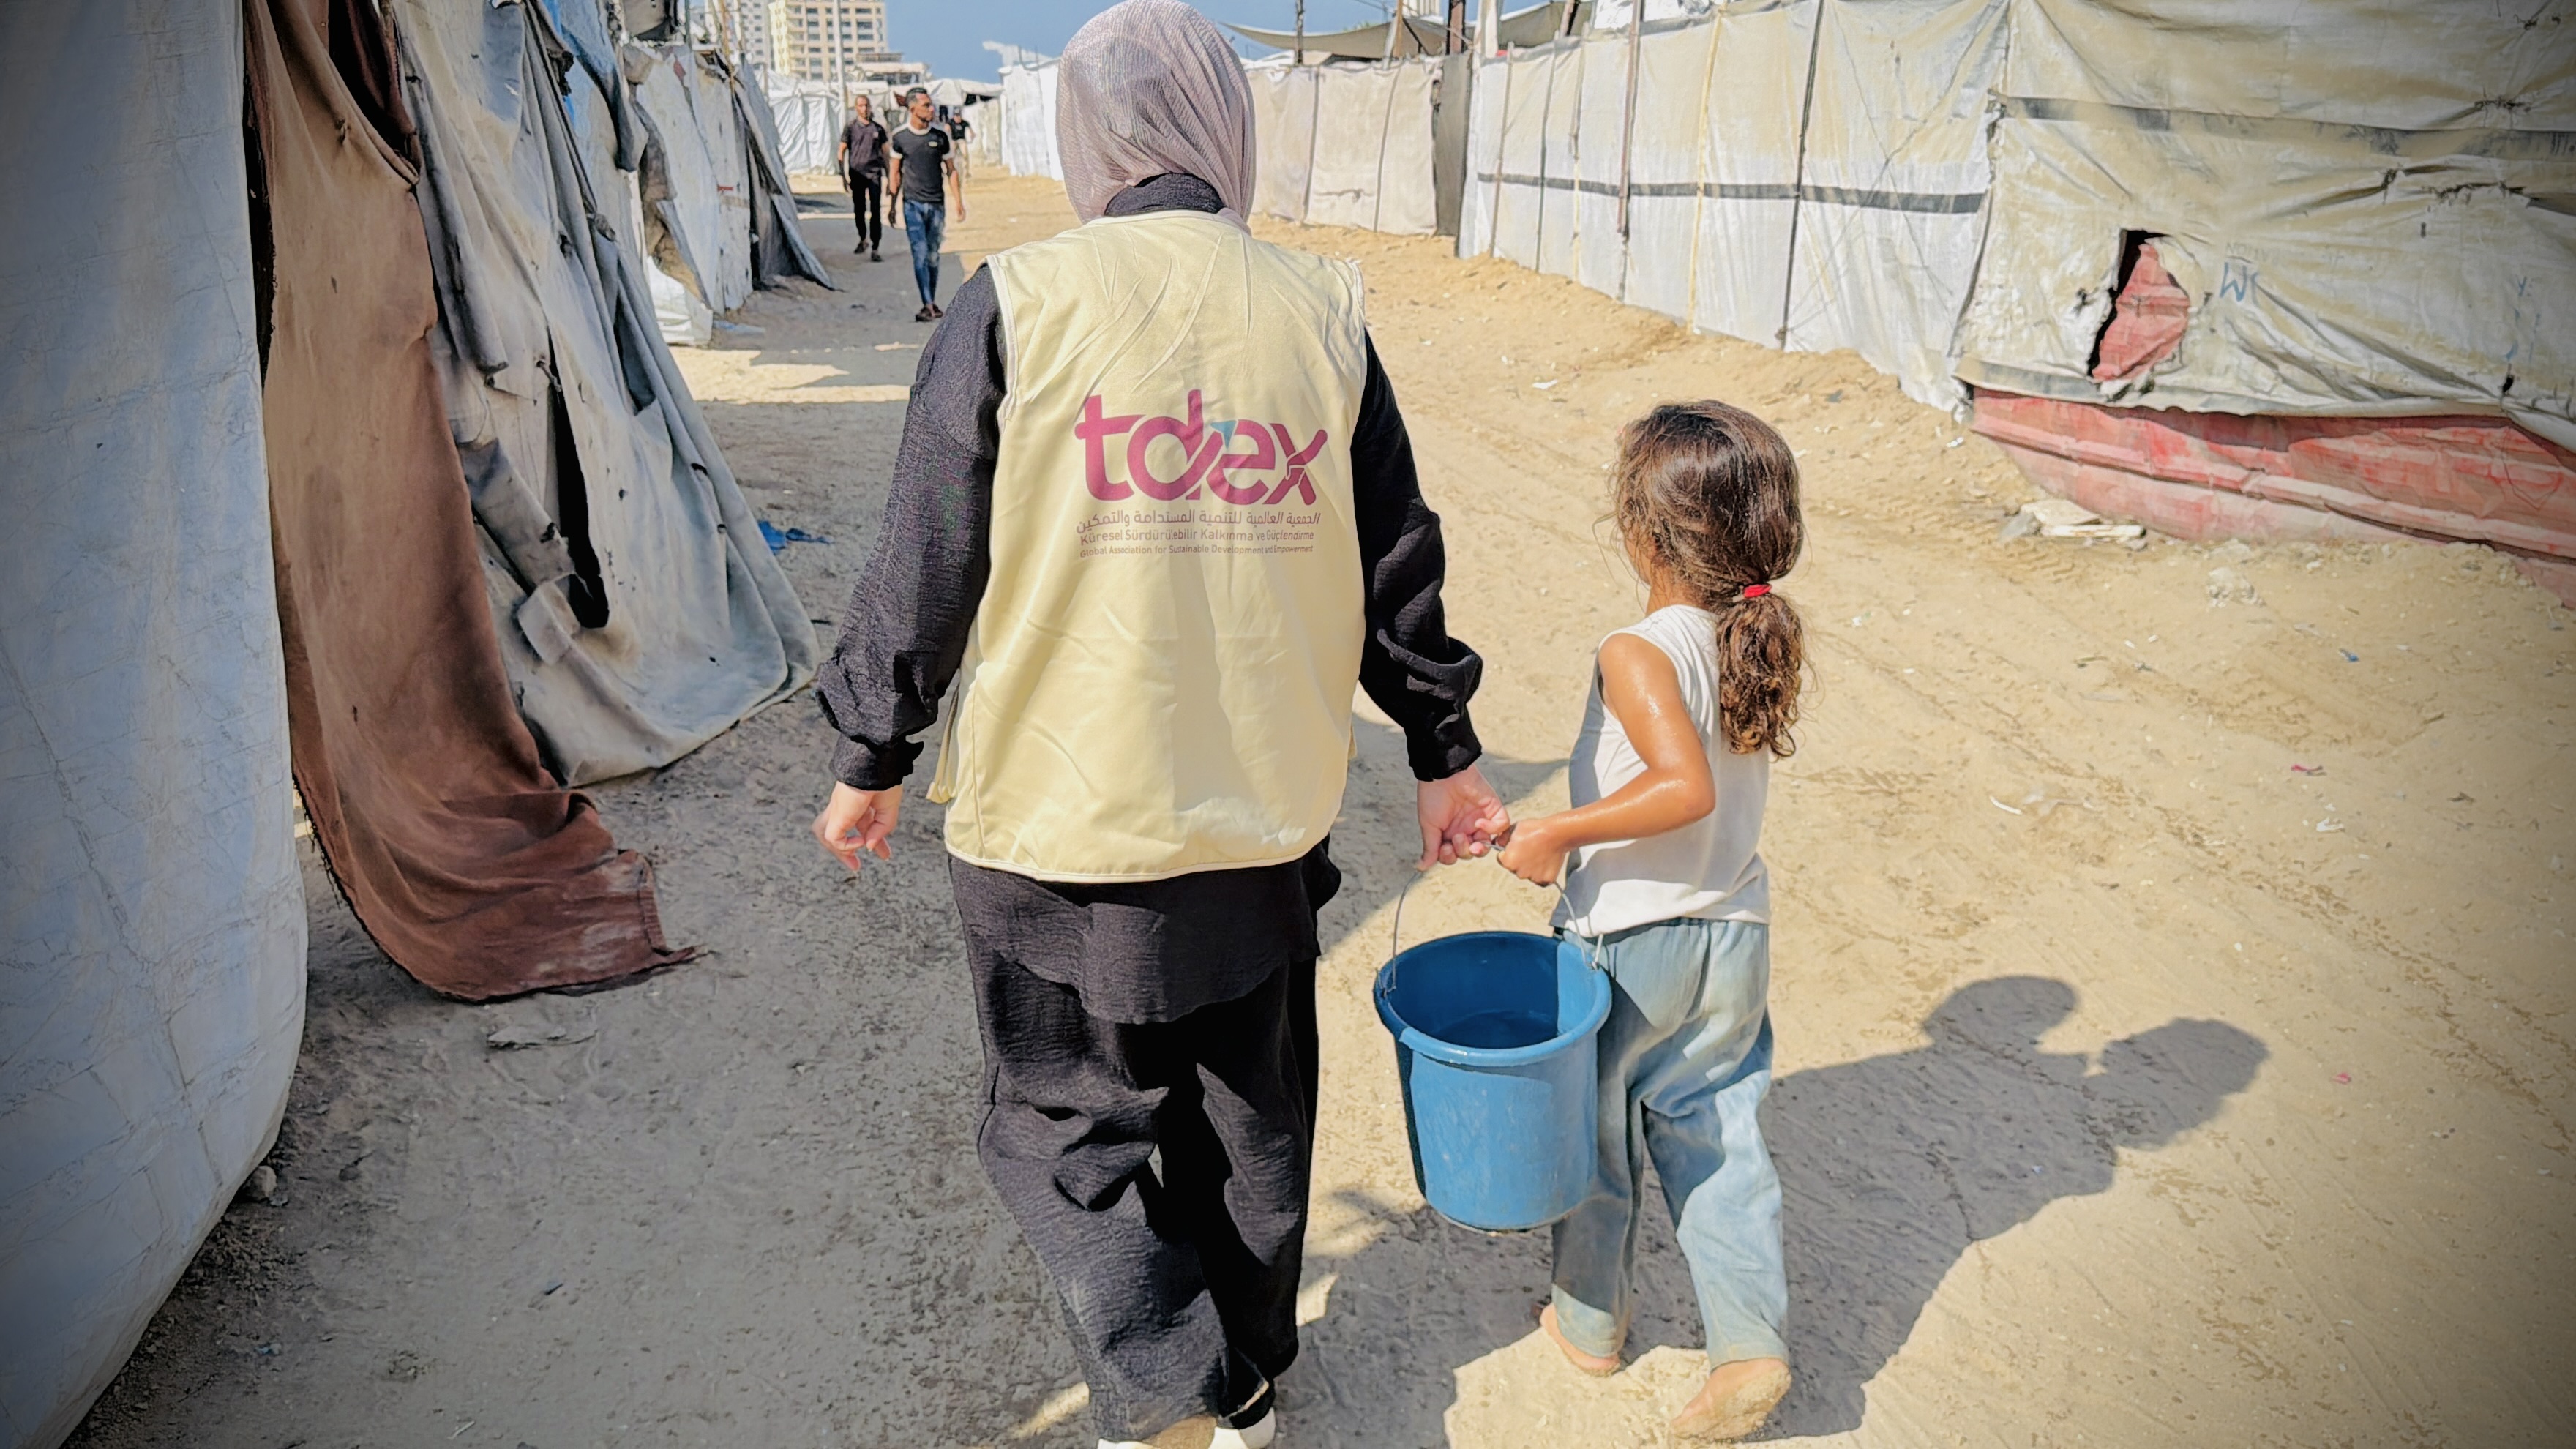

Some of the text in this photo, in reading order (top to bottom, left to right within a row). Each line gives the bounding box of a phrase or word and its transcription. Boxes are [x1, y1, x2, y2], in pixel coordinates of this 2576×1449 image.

[1076, 509, 1321, 534] الجمعية العالمية للتنمية المستدامة والتمكين
[1080, 528, 1314, 545] Küresel Sürdürülebilir Kalkınma ve Güçlendirme
[1079, 548, 1108, 558] Global
[1109, 546, 1153, 555] Association
[1155, 545, 1167, 555] for
[1169, 545, 1210, 554] Sustainable
[1211, 544, 1264, 555] Development
[1273, 545, 1314, 553] Empowerment
